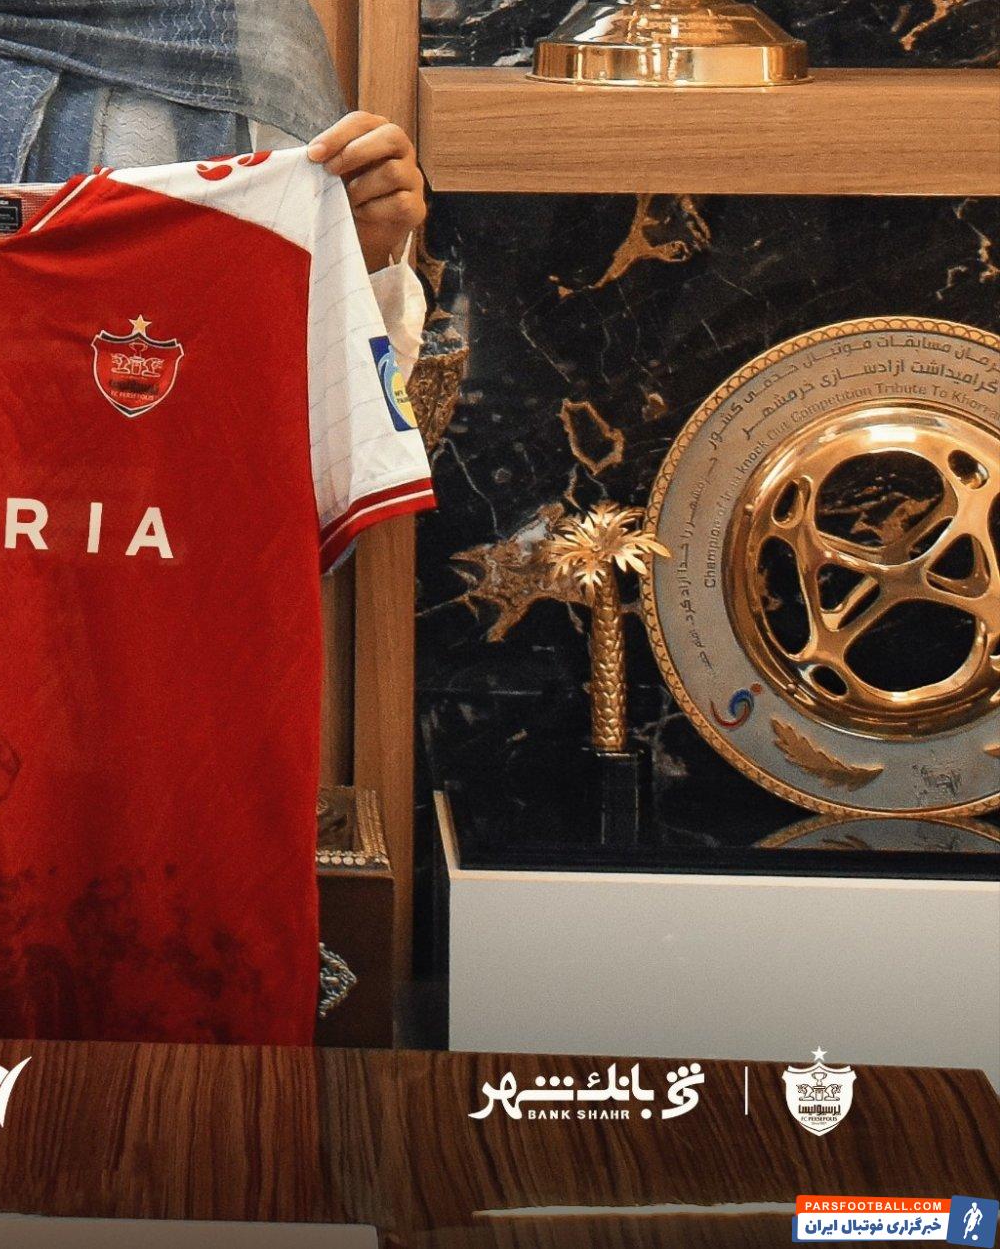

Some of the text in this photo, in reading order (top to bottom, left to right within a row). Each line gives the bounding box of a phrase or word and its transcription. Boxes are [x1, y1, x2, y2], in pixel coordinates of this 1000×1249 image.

[802, 337, 872, 369] فوتبال
[877, 334, 951, 354] مسابقات
[875, 382, 927, 395] Tribute
[931, 384, 947, 397] To
[951, 390, 1000, 422] Khorra
[709, 400, 744, 450] کشور
